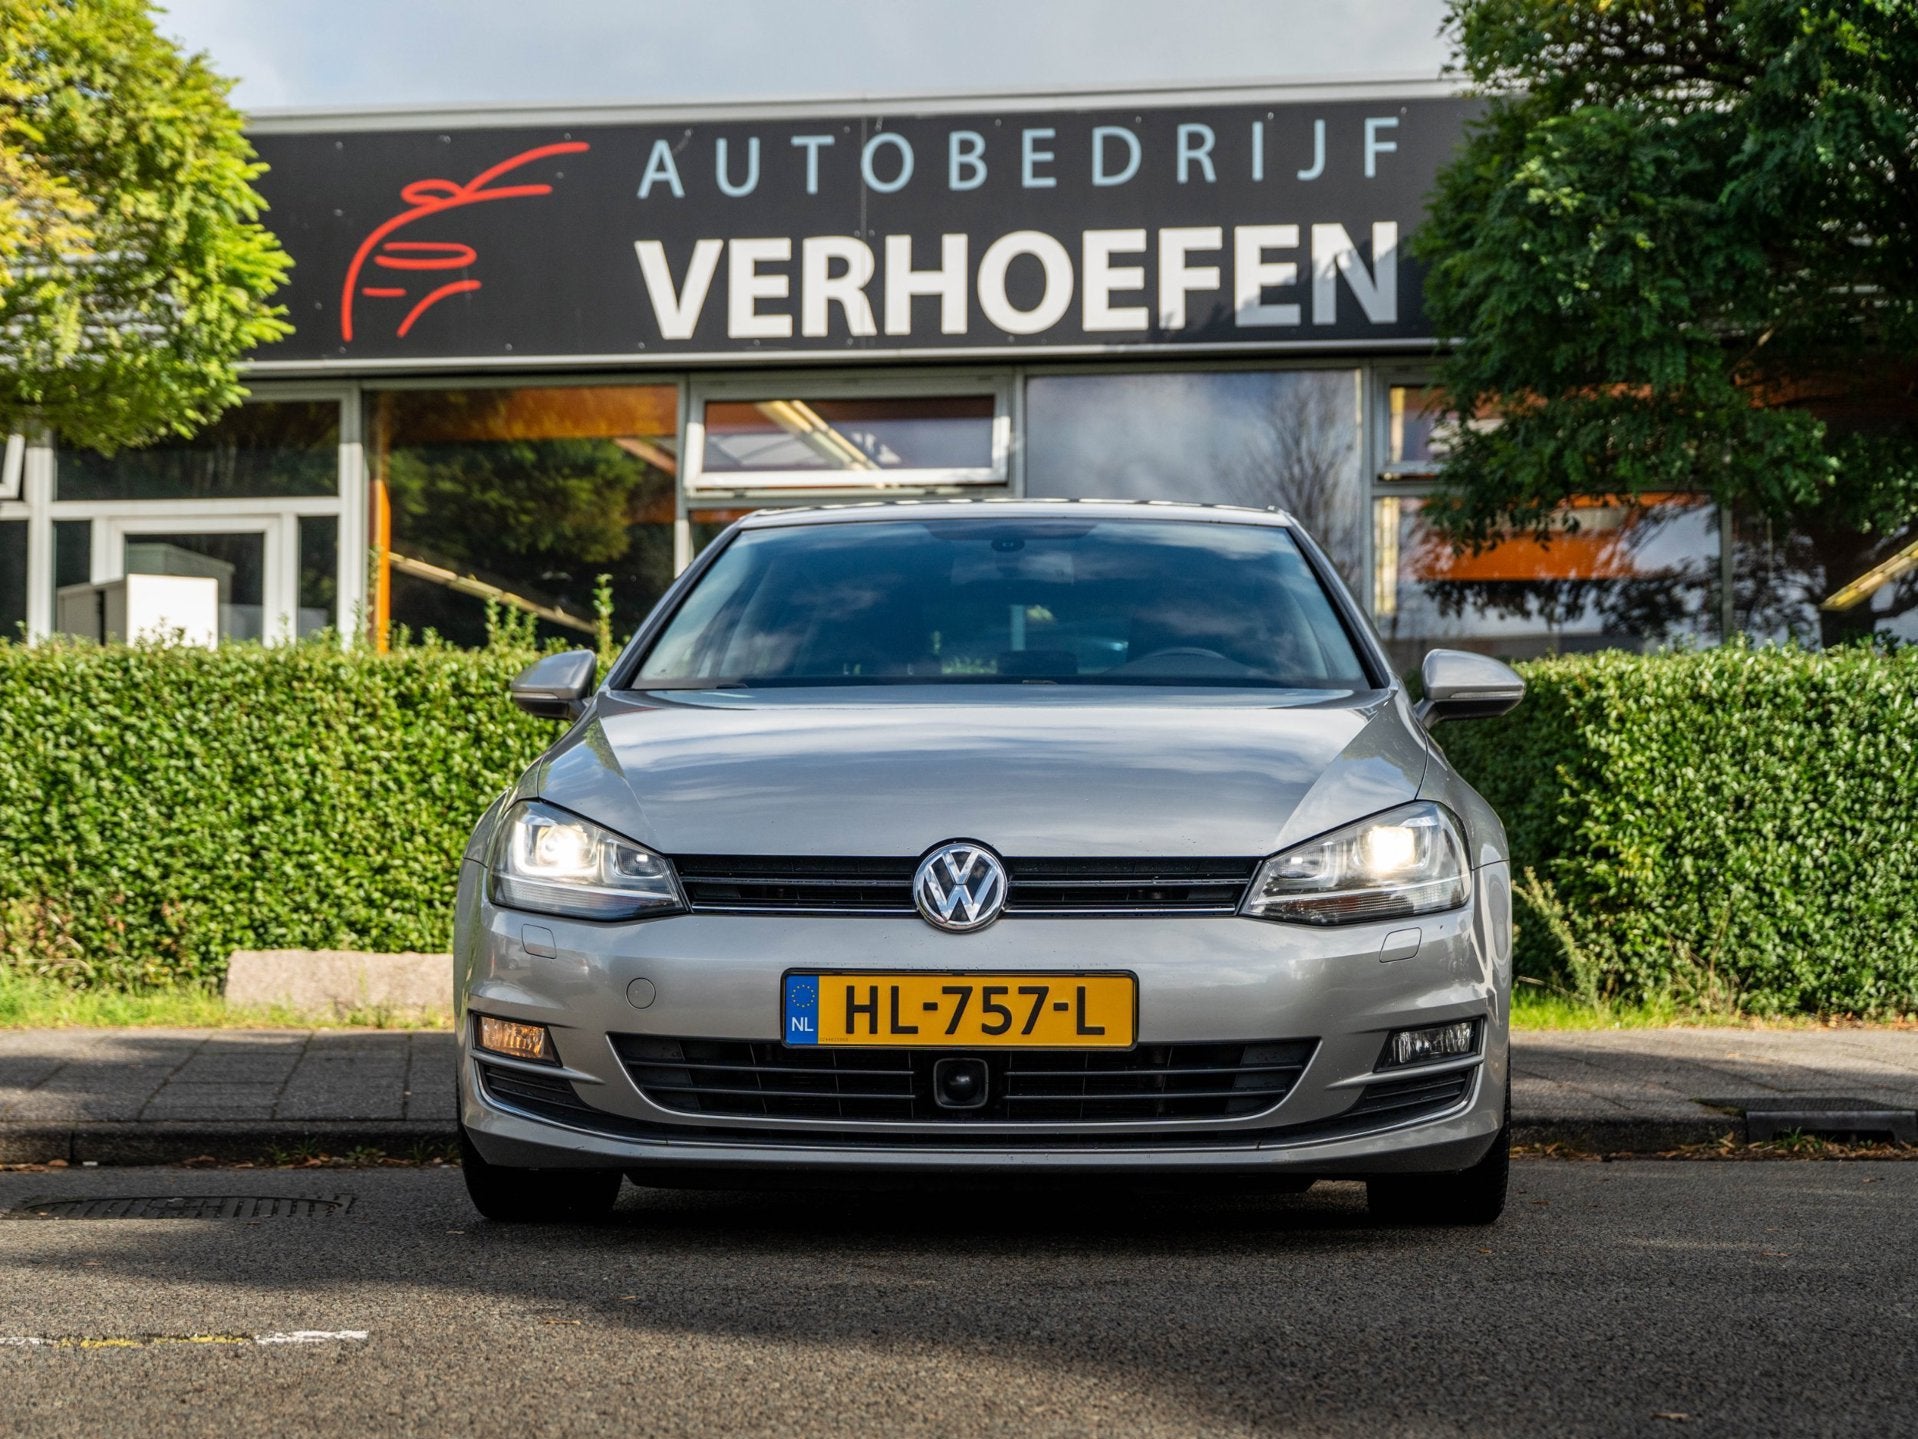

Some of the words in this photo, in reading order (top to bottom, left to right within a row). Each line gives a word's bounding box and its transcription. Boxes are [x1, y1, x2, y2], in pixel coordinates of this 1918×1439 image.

[637, 117, 1399, 199] AUTOBEDRIJF
[634, 221, 1399, 340] VERHOEFEN
[922, 848, 1000, 925] VW
[791, 1016, 814, 1032] NL
[845, 985, 1105, 1036] HL-757-L
